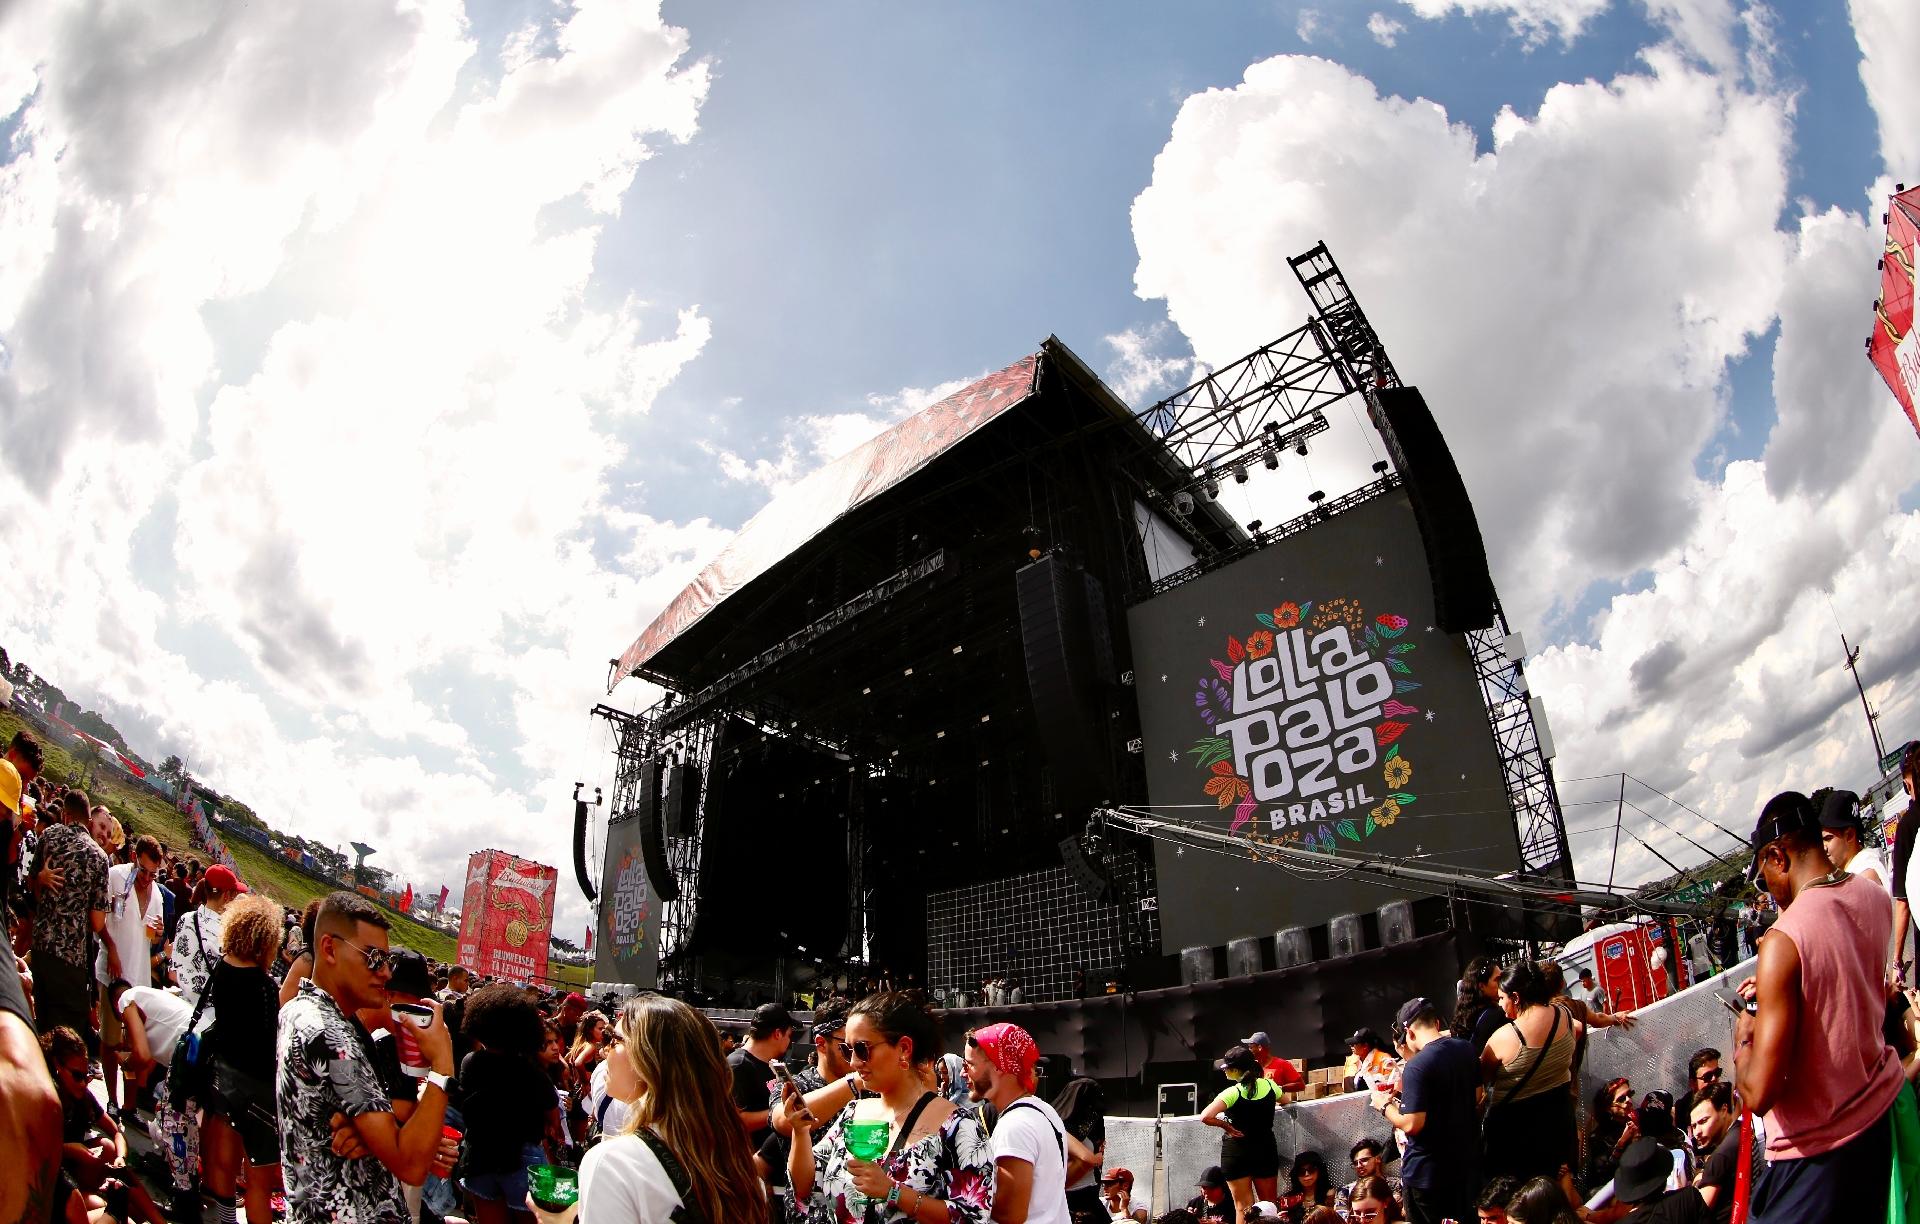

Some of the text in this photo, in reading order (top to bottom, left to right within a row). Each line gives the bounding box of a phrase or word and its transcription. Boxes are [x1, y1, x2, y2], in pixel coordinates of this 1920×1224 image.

[1269, 783, 1375, 832] BRASIL
[616, 934, 635, 945] BRASIL
[493, 948, 535, 967] BUDWEISER
